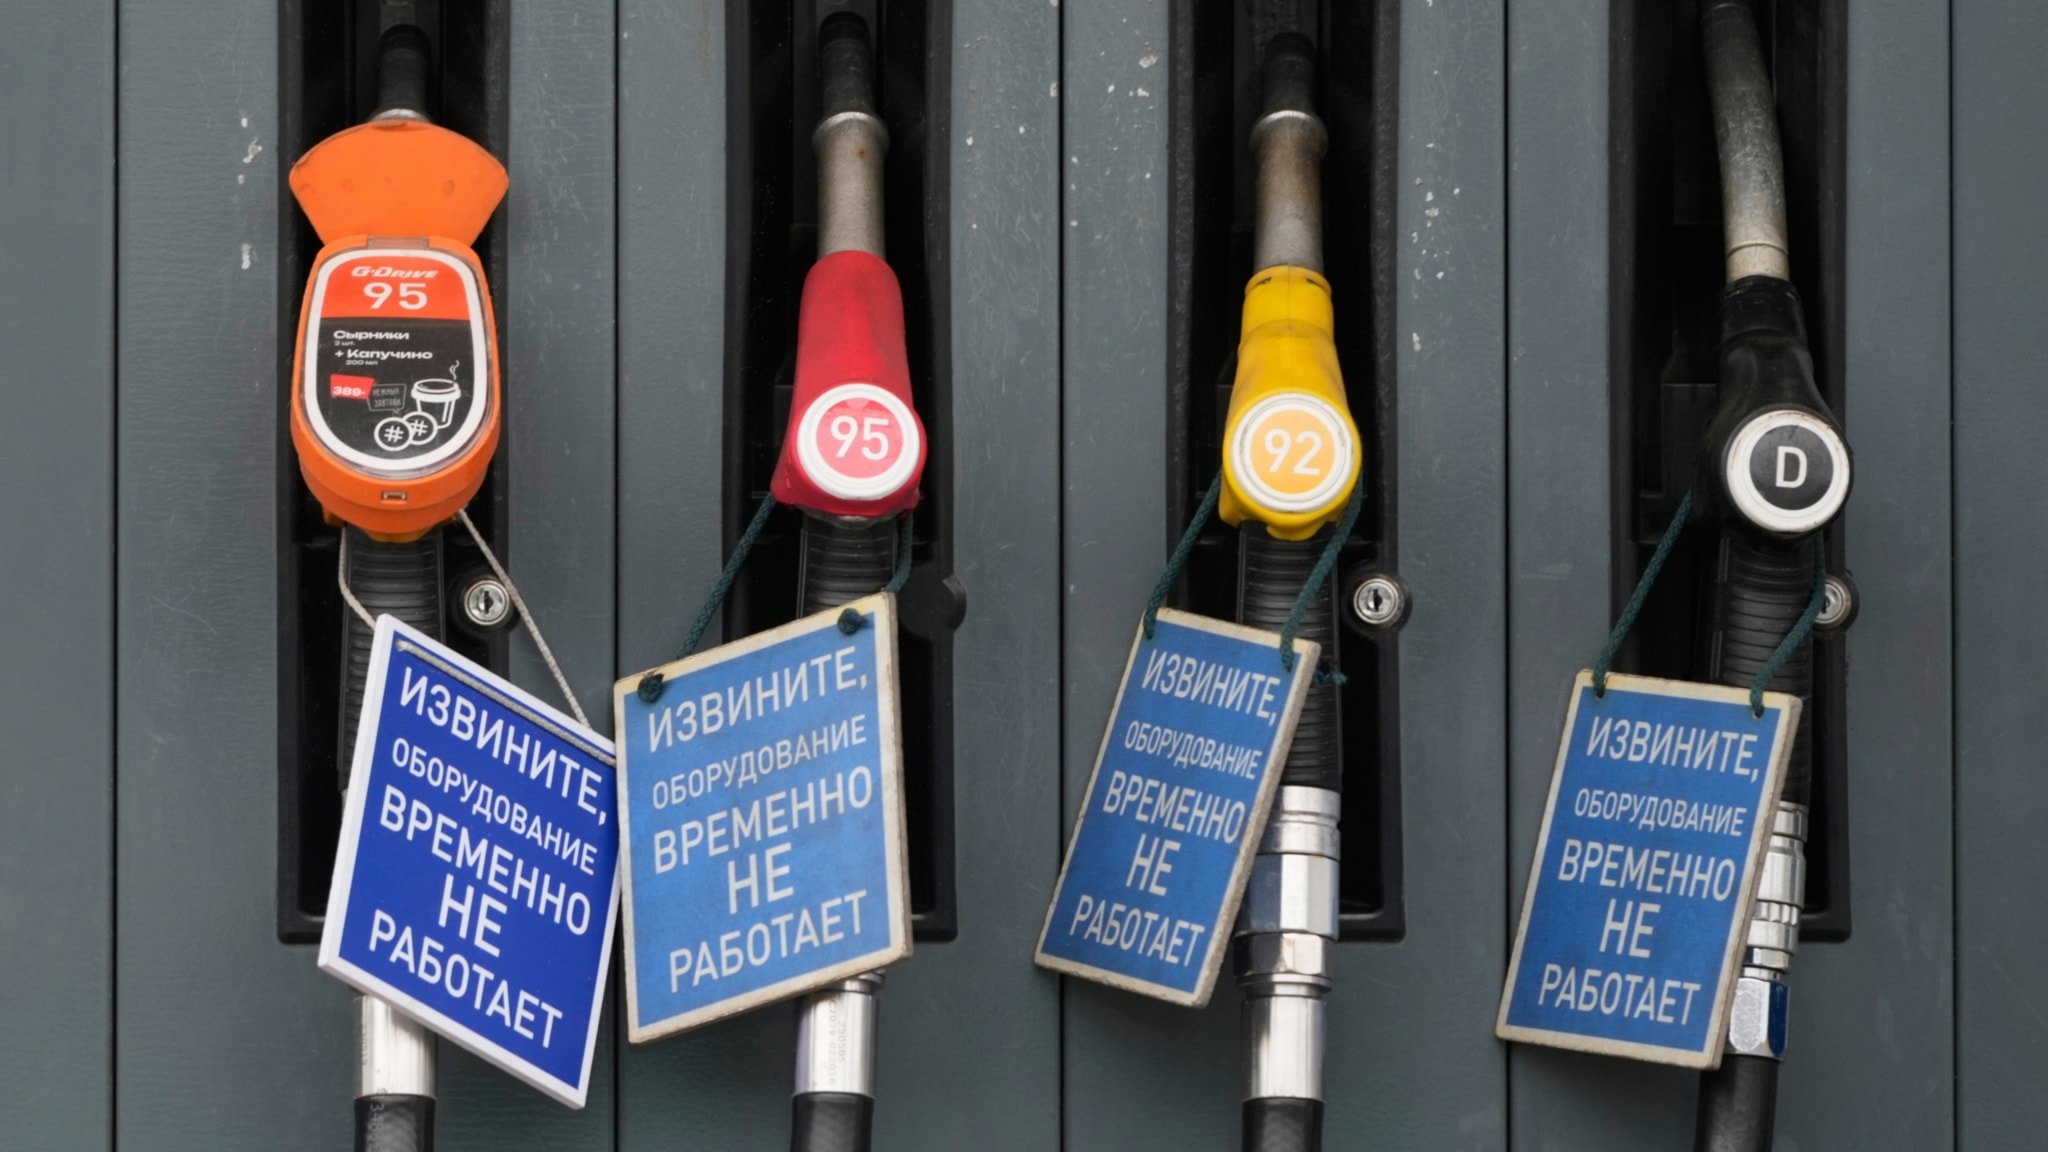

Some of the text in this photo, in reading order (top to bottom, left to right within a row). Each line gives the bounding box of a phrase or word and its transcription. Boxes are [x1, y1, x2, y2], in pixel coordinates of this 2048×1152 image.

[363, 282, 428, 310] 95
[333, 330, 410, 340] Сырники
[347, 349, 433, 360] Капучино
[830, 415, 890, 461] 95
[1264, 427, 1323, 476] 92
[1775, 445, 1808, 489] D
[648, 646, 868, 752] ИЗВИНИТЕ,
[1141, 648, 1281, 726] ИЗВИНИТЕ,
[400, 666, 607, 826] ИЗВИНИТЕ,
[652, 714, 867, 810] ОБОРУДОВАНИЕ
[1124, 720, 1263, 780] ОБОРУДОВАНИЕ
[1586, 716, 1759, 783] ИЗВИНИТЕ,
[391, 738, 598, 875] ОБОРУДОВАНИЕ
[654, 766, 873, 874] ВРЕМЕННО
[1102, 770, 1246, 844] ВРЕМЕННО
[1574, 788, 1747, 837] ОБОРУДОВАНИЕ
[380, 785, 592, 936] ВРЕМЕННО
[727, 843, 794, 914] НЕ
[1126, 833, 1181, 896] НЕ
[1557, 839, 1736, 901] ВРЕМЕННО
[438, 873, 509, 957] НЕ
[669, 889, 867, 993] РАБОТАЕТ
[1069, 894, 1205, 967] РАБОТАЕТ
[1599, 898, 1661, 959] НЕ
[368, 909, 563, 1049] РАБОТАЕТ
[1537, 963, 1701, 1026] РАБОТАЕТ
